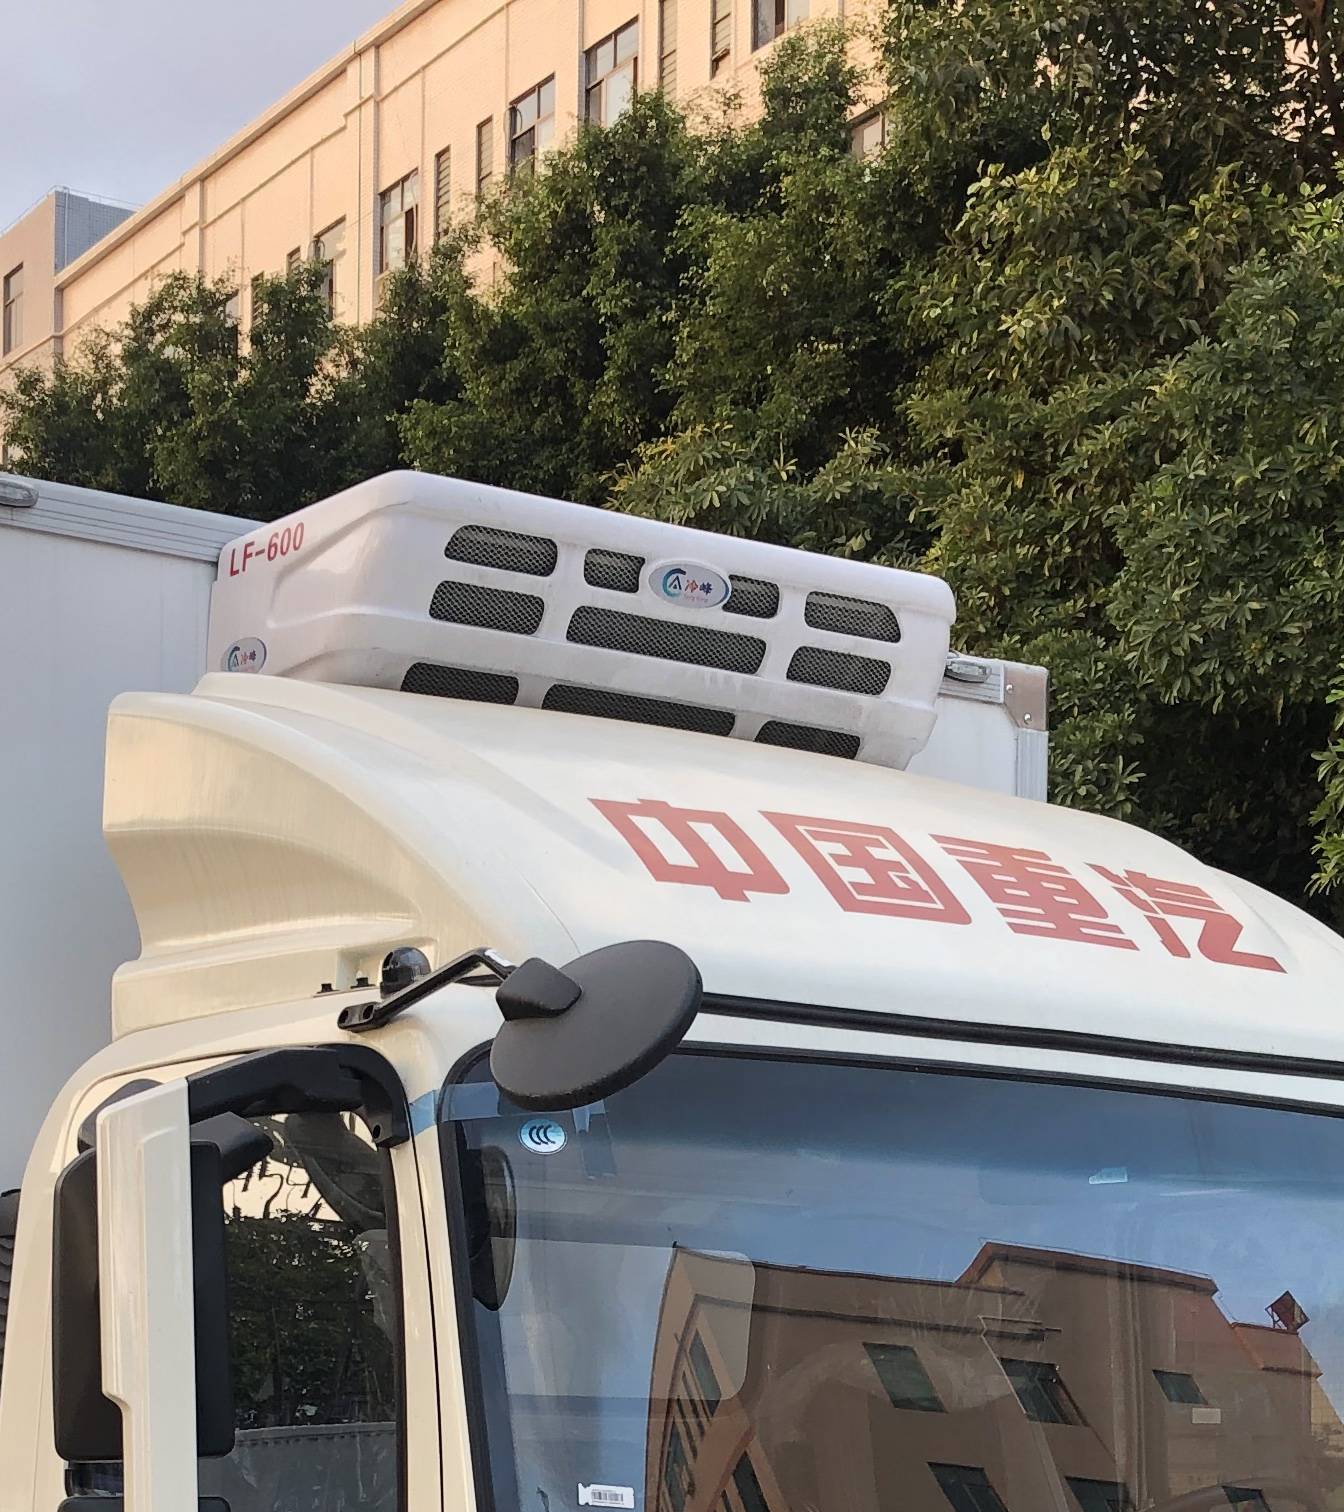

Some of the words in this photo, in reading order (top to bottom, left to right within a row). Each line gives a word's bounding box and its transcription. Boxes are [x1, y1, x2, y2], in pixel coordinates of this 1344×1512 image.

[230, 522, 304, 576] LF-600
[589, 798, 1287, 973] 中国重汽
